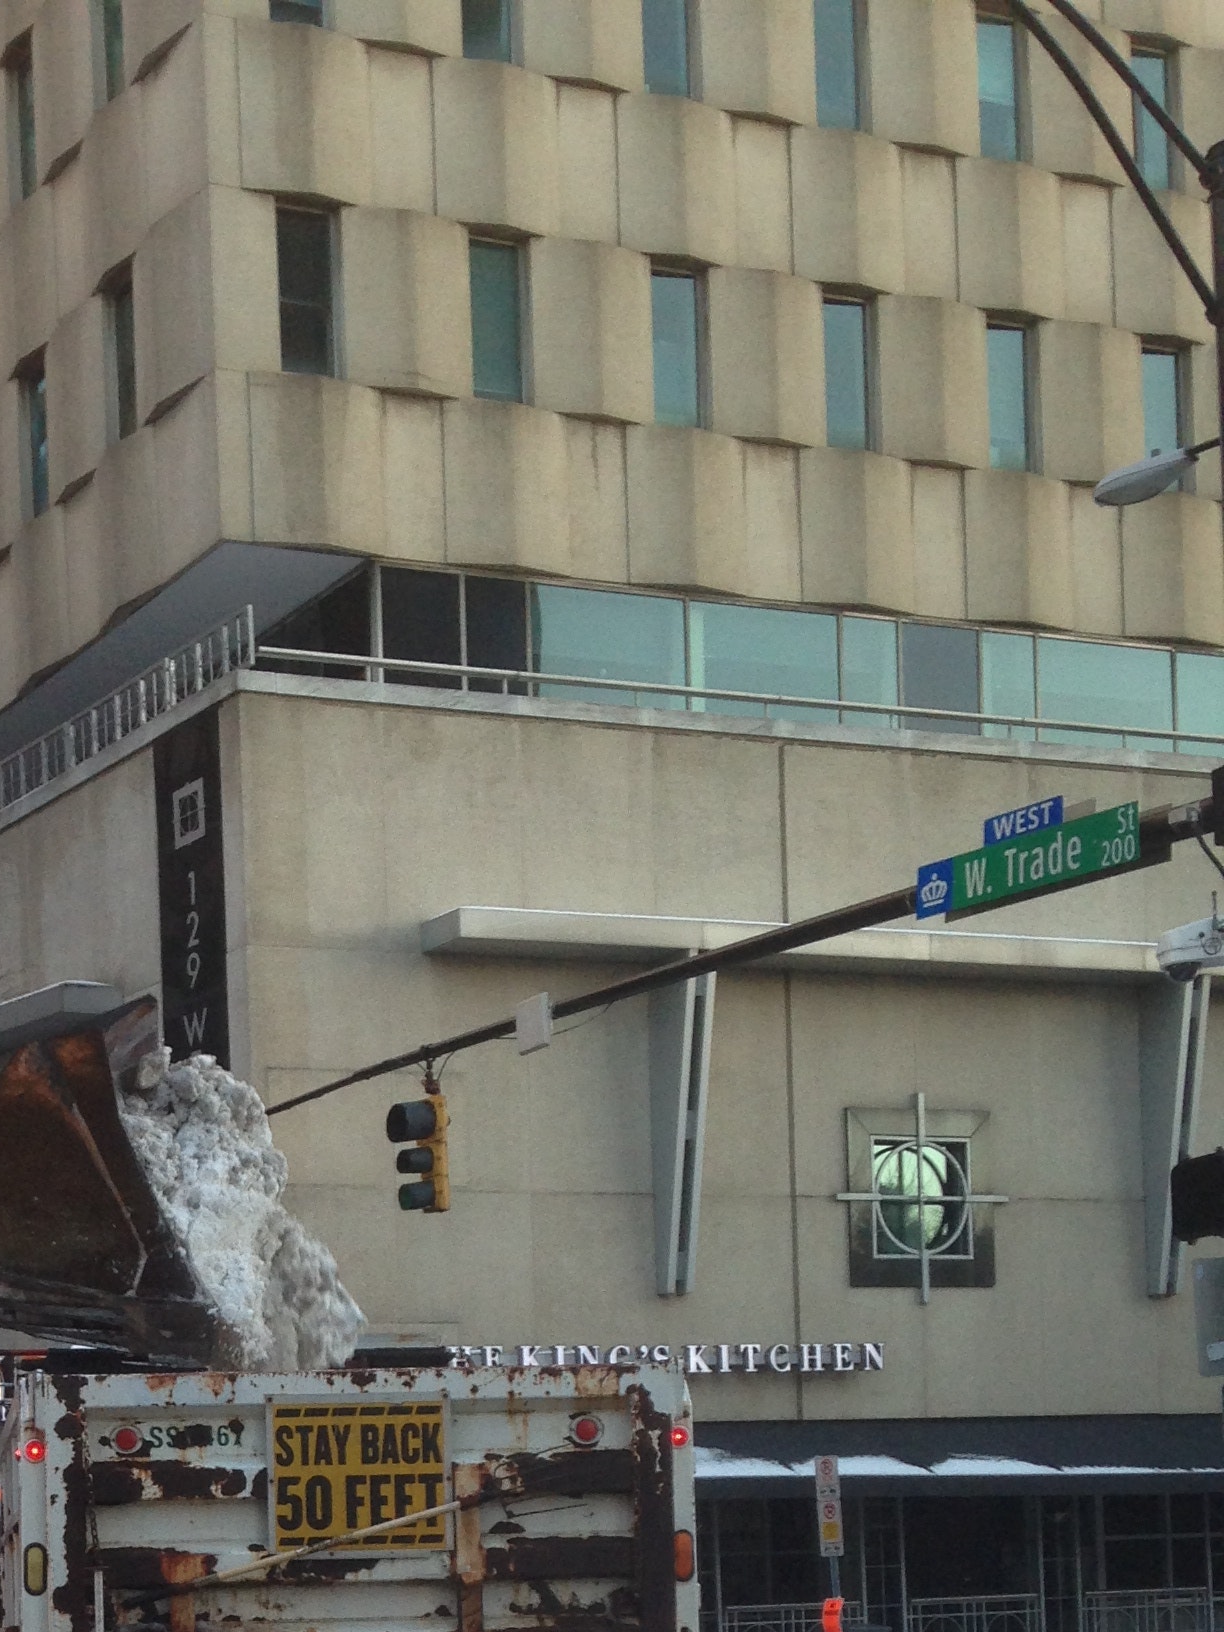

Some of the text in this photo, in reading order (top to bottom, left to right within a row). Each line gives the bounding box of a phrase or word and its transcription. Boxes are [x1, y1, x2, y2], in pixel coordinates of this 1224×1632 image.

[992, 801, 1054, 841] WEST
[1117, 804, 1135, 834] St
[964, 831, 1082, 898] W. Trade
[1101, 834, 1136, 867] 200
[183, 870, 207, 1047] 129 W
[686, 1343, 885, 1374] KITCHEN
[275, 1423, 443, 1467] STAY BACK
[276, 1473, 444, 1531] 50 FEET
